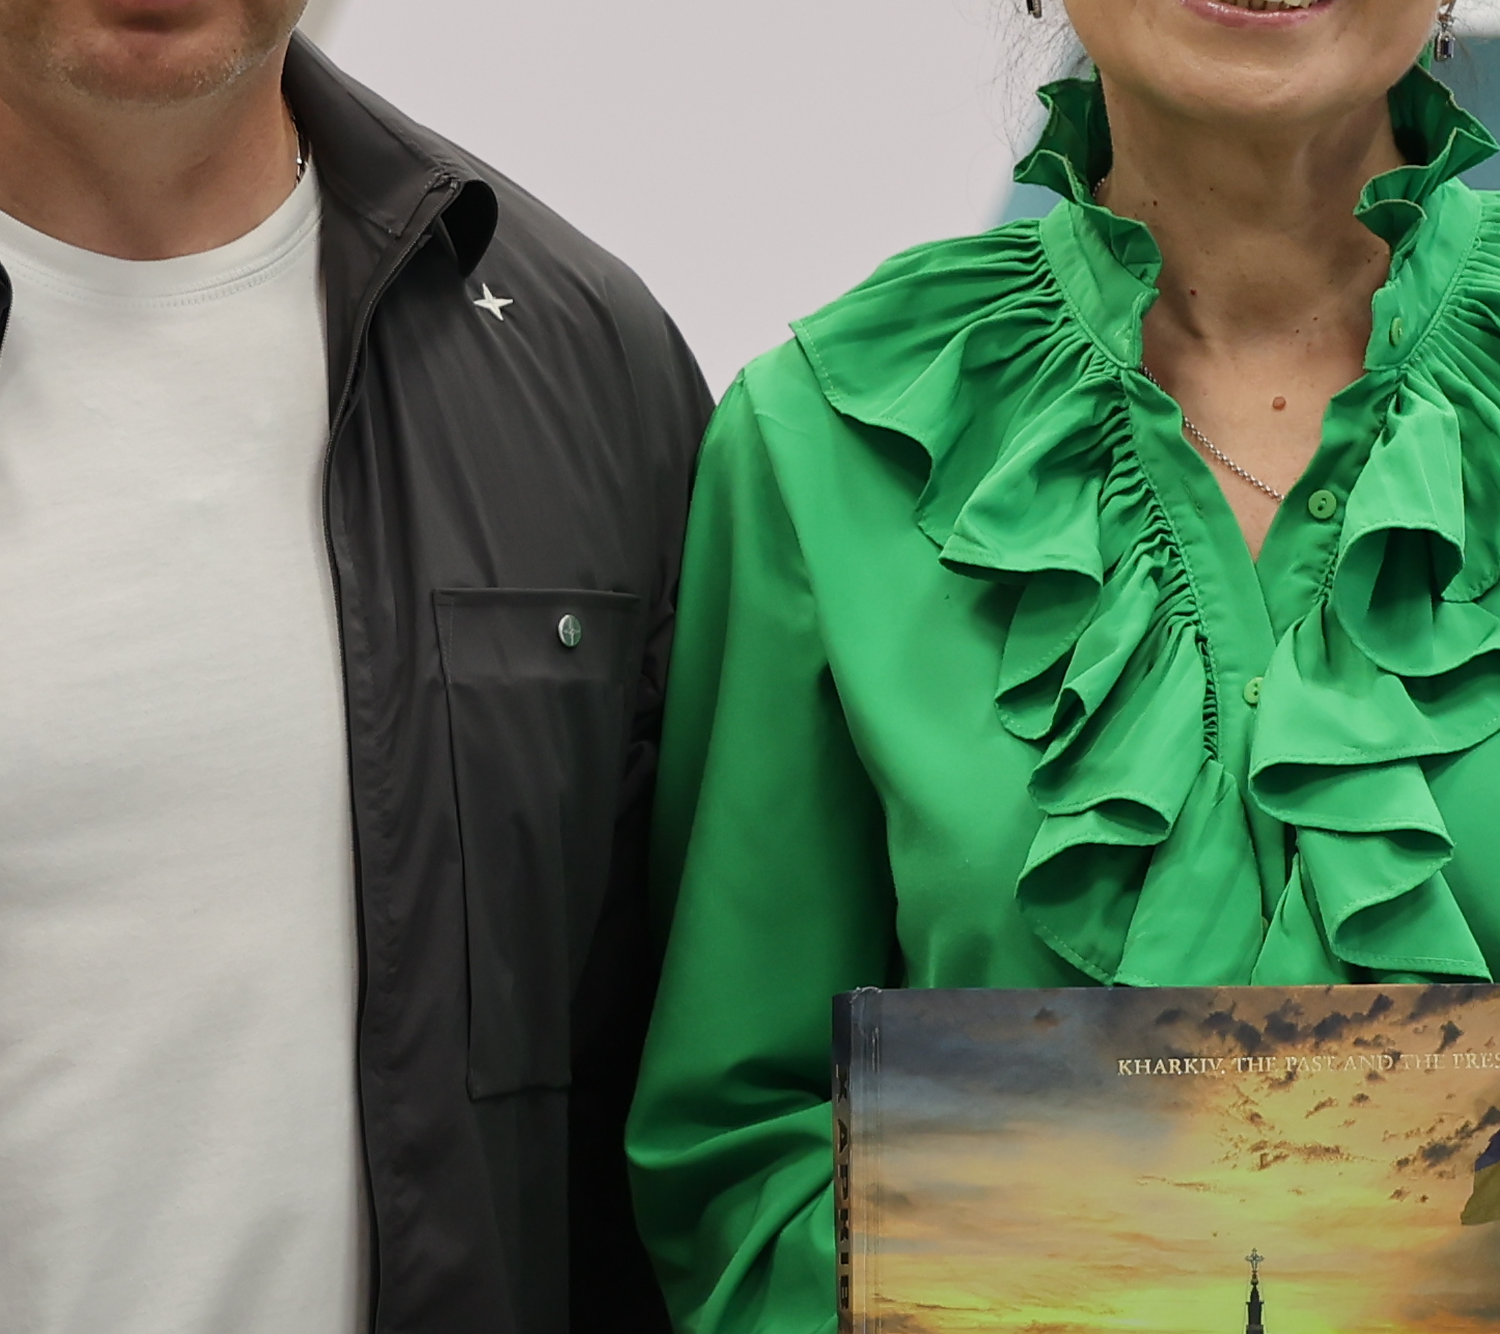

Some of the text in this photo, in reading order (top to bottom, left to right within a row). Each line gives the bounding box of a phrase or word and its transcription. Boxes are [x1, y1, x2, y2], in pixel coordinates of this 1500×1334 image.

[1116, 1057, 1226, 1077] KHARKIV.
[1231, 1055, 1277, 1075] THE
[1285, 1054, 1337, 1073] PAST
[1344, 1054, 1394, 1071] AND
[1401, 1053, 1446, 1069] THE
